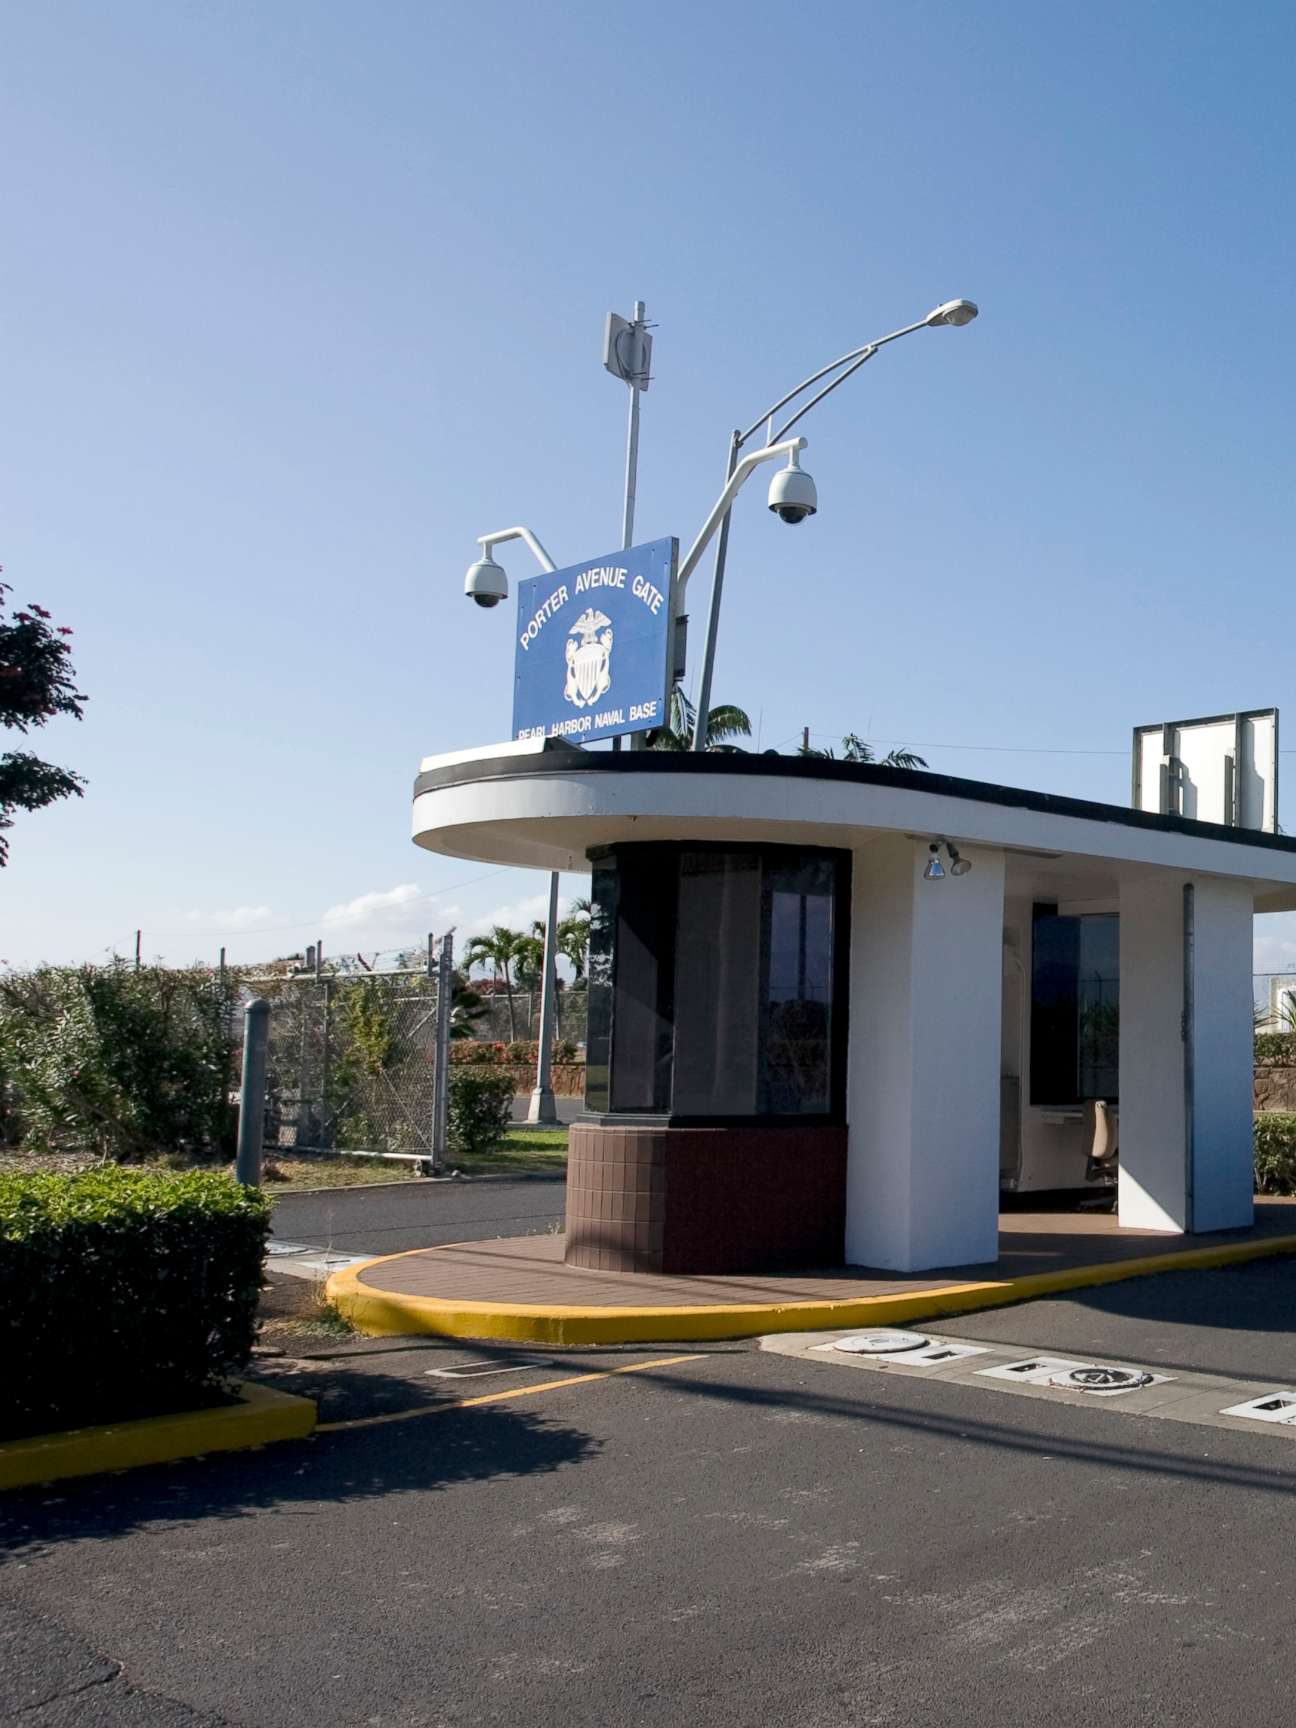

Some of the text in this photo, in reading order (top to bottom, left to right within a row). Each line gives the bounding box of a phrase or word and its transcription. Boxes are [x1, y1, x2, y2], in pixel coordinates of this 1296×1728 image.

[520, 567, 664, 650] PORTER AVENUE GATE
[551, 715, 592, 736] HARBOR
[594, 709, 625, 729] NAVAL
[629, 701, 657, 721] BASE
